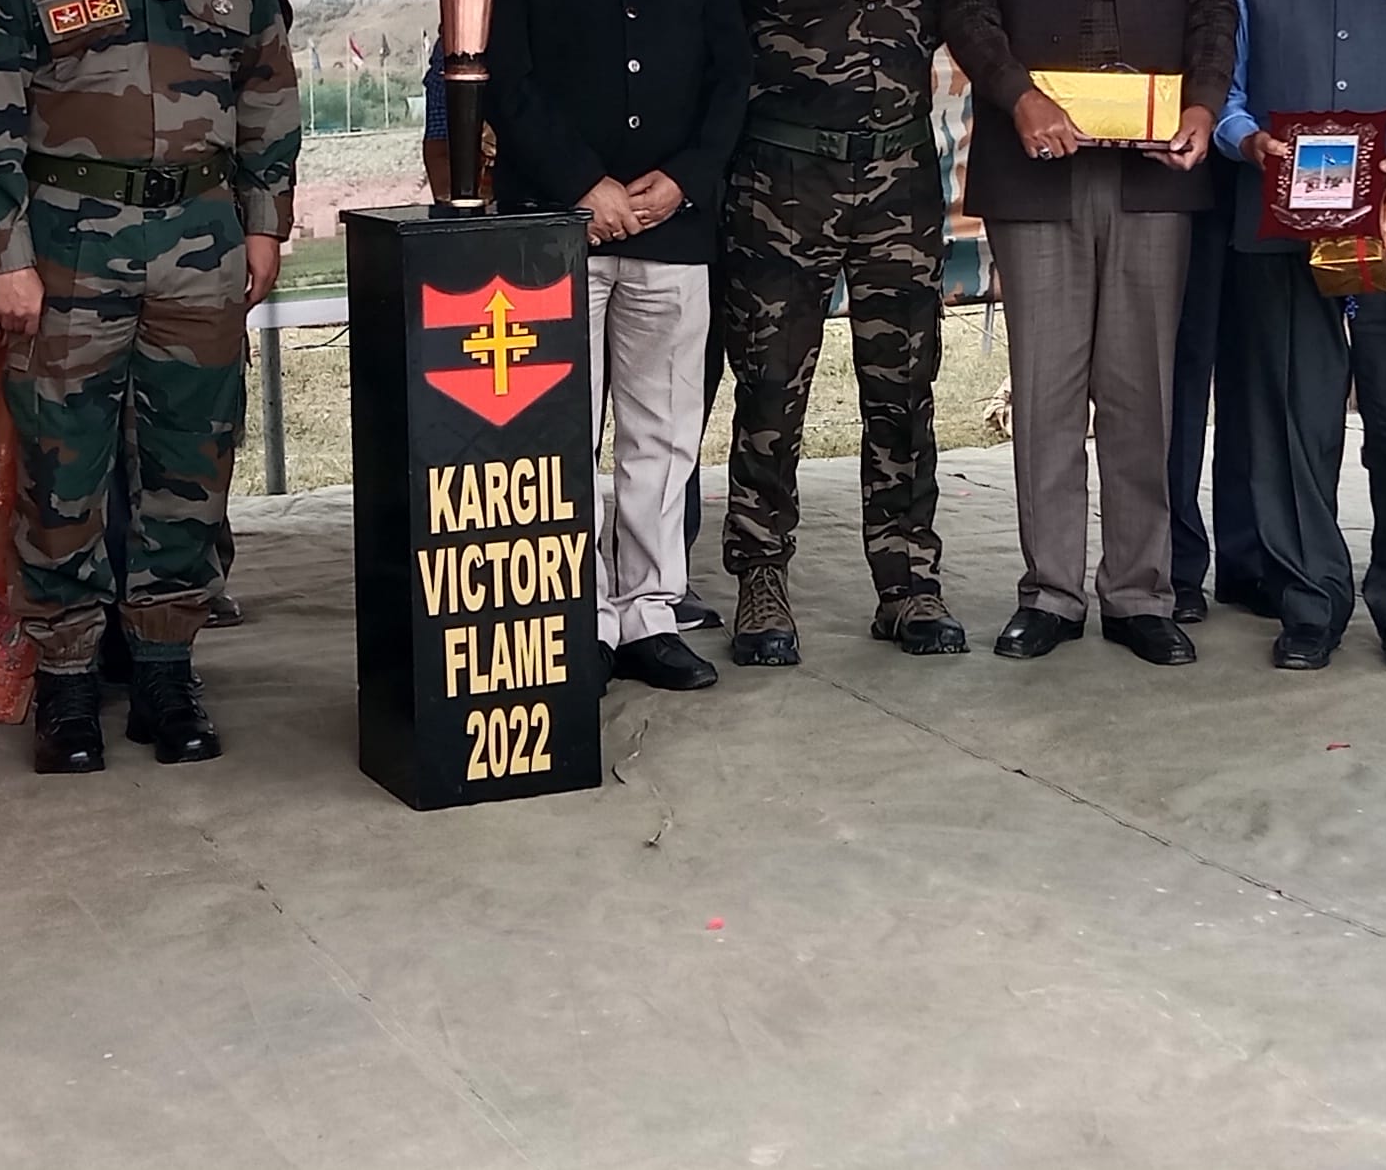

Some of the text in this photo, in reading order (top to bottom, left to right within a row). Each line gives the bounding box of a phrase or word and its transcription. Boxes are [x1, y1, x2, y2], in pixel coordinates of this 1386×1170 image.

[428, 455, 574, 534] KARGIL
[417, 532, 588, 616] VICTORY
[444, 615, 567, 698] FLAME
[466, 702, 552, 782] 2022
